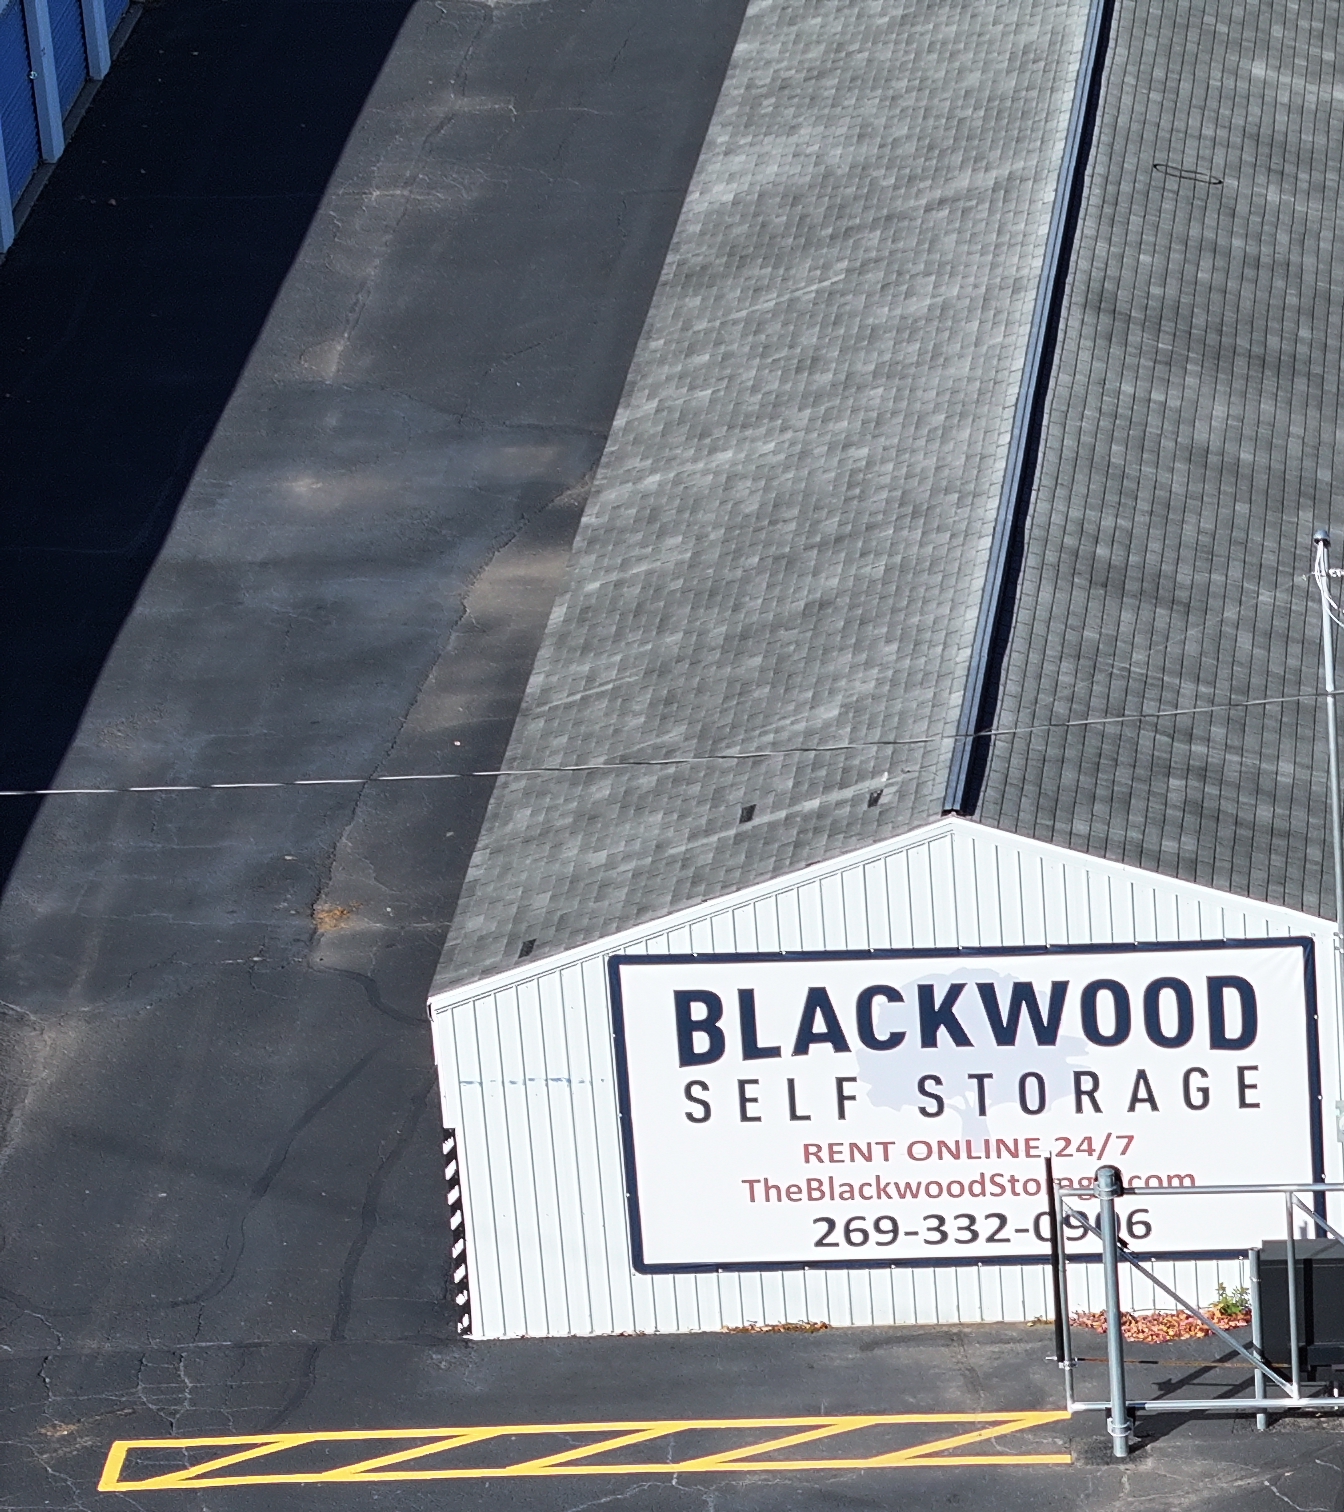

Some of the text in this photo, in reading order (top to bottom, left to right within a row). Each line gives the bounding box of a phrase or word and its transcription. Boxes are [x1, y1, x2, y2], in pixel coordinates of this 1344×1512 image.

[673, 975, 1258, 1068] BLACKWOOD
[684, 1064, 1261, 1124] SELF STORAGE
[803, 1132, 1135, 1164] RENT ONLINE 24/7
